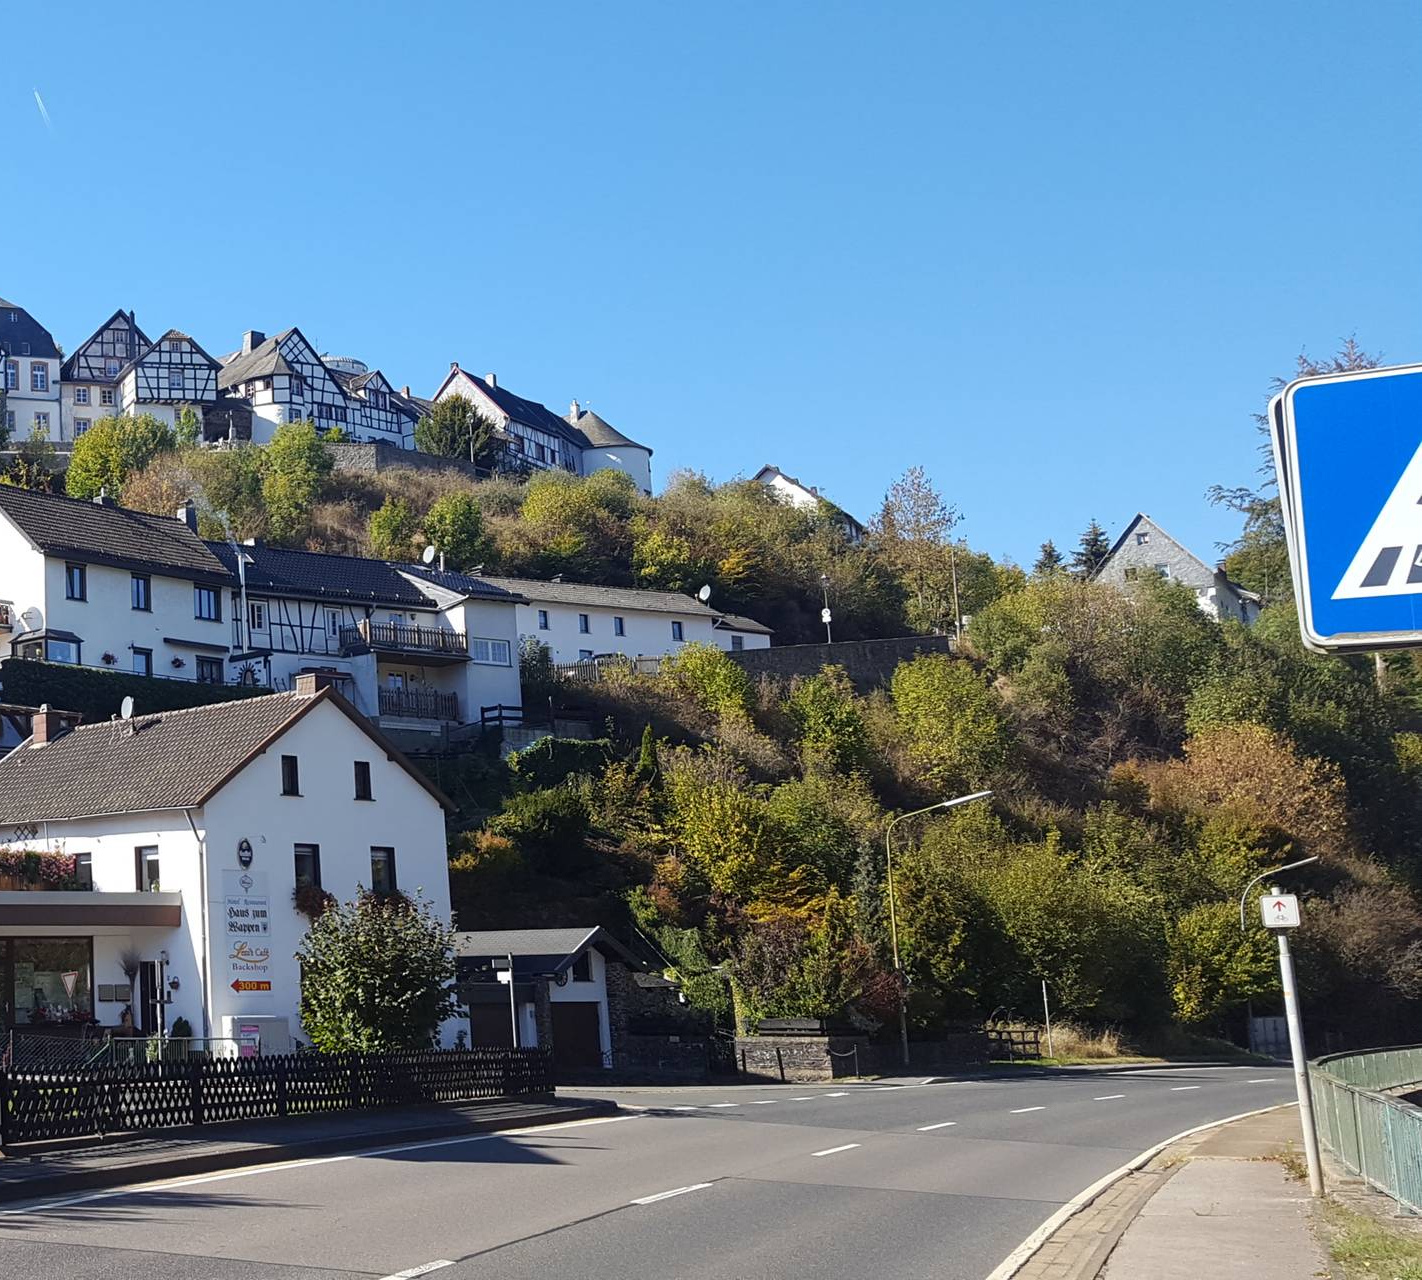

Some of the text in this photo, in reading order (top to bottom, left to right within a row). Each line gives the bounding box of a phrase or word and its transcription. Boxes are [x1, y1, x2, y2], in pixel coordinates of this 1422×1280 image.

[227, 907, 267, 919] Haus zum
[228, 921, 260, 933] Wappen
[232, 963, 268, 973] Backshop
[238, 981, 257, 990] 300
